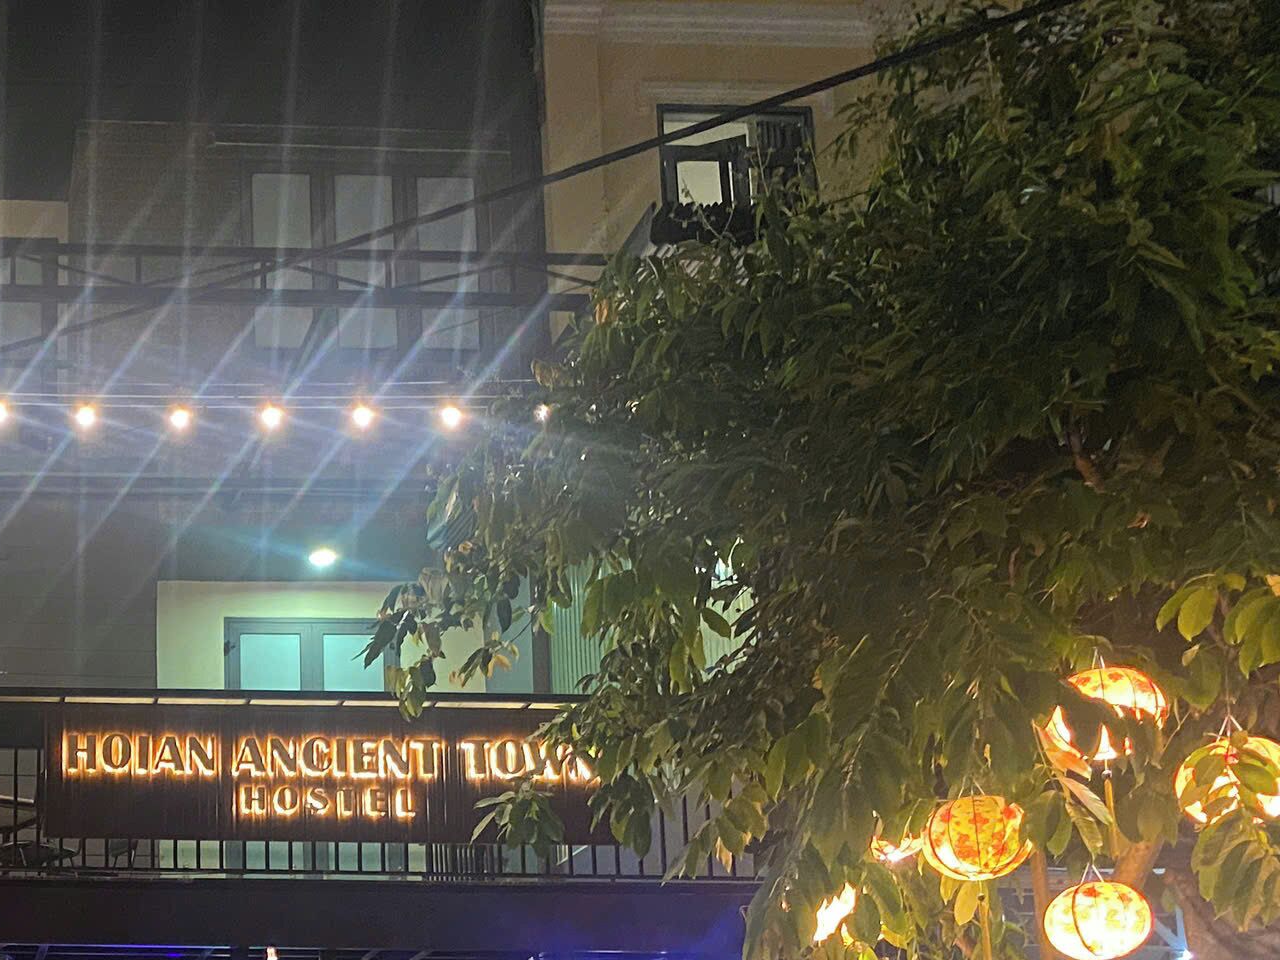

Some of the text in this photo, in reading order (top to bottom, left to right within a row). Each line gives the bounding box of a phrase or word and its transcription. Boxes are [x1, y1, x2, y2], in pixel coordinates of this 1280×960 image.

[67, 733, 217, 775] HOIAN
[232, 735, 444, 778] ANCIENT
[241, 784, 417, 817] HOSTEL
